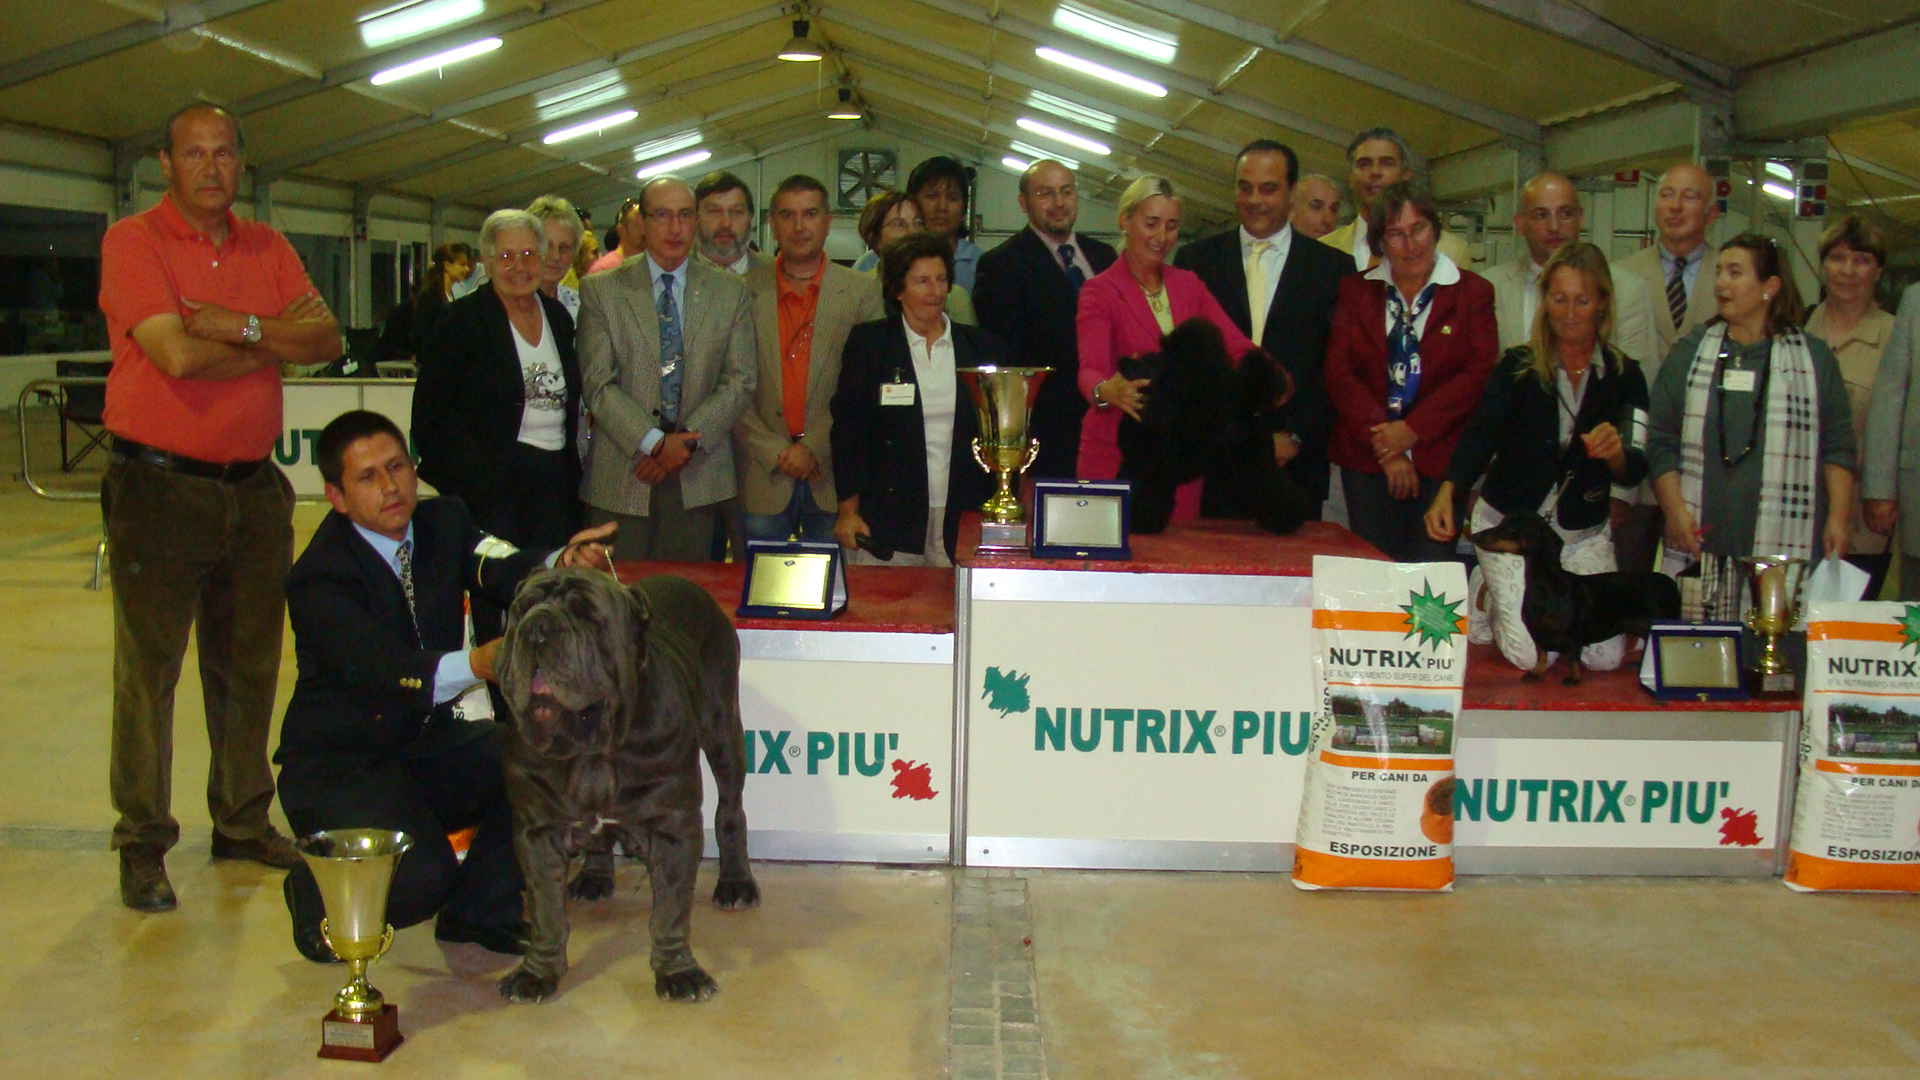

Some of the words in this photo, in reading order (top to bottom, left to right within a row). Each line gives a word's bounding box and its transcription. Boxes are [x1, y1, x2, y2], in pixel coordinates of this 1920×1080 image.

[1232, 710, 1311, 756] PIU
[1351, 771, 1376, 781] PER
[1380, 772, 1409, 782] CANI
[1413, 773, 1428, 783] DA
[1878, 778, 1907, 788] CANI
[1911, 779, 1920, 789] D
[1329, 841, 1438, 858] ESPOSIZIONE
[1827, 846, 1920, 862] ESPOSIZION
